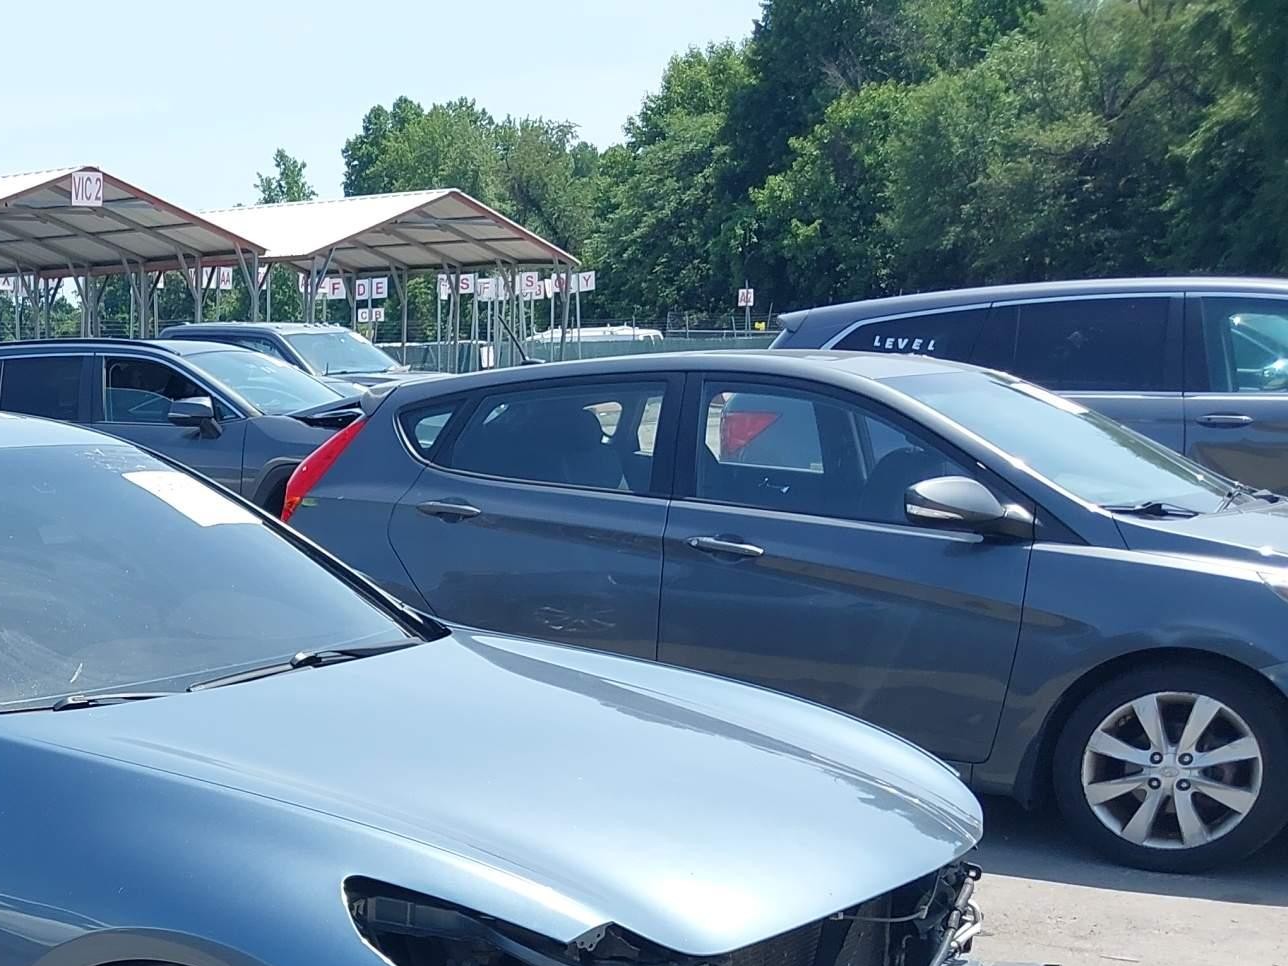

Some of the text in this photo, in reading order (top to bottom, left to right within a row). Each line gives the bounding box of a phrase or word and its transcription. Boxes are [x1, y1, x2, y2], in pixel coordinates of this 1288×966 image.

[73, 175, 102, 201] VIC 2
[375, 281, 384, 295] E
[460, 277, 470, 290] S
[525, 275, 534, 288] S
[583, 274, 592, 288] Y
[331, 282, 341, 296] F
[357, 283, 366, 297] D
[360, 311, 368, 320] C
[374, 310, 382, 320] B
[873, 335, 935, 351] LEVEL
